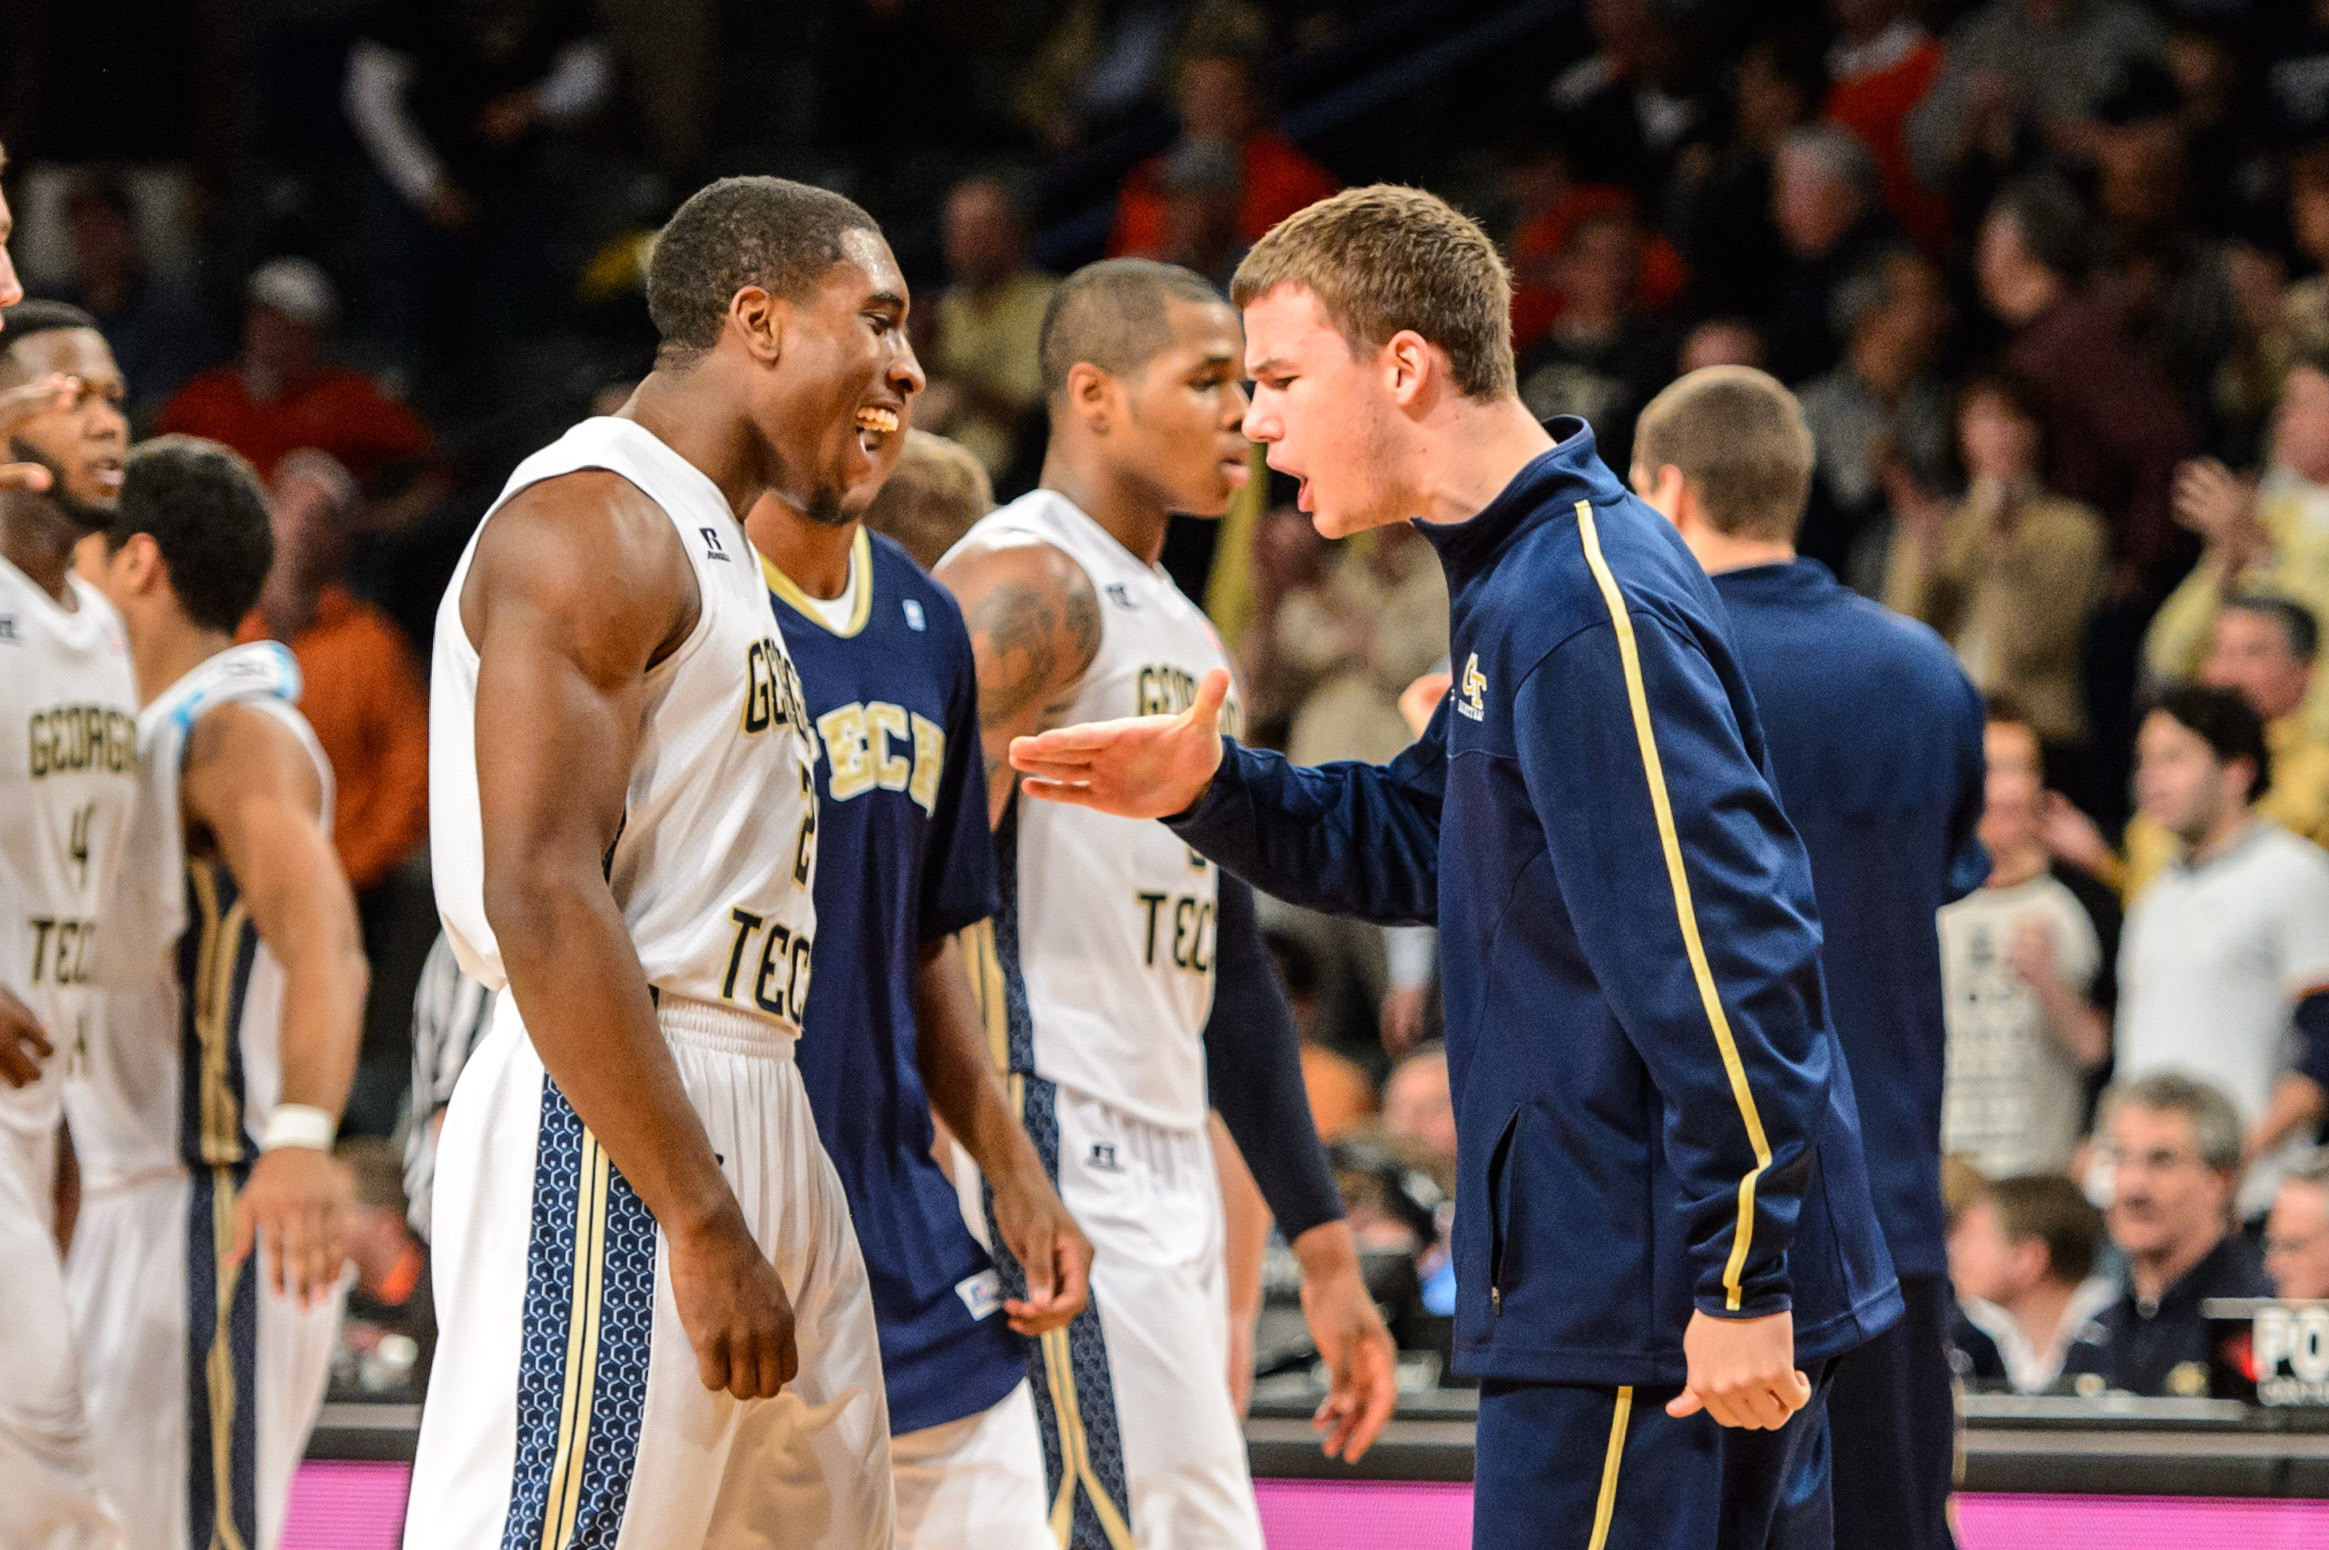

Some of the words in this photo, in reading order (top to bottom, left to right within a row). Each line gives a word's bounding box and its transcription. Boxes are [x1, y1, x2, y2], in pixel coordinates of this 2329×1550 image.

[808, 700, 946, 819] ECH
[29, 916, 98, 985] TEC
[720, 905, 811, 1028] TEC
[1133, 889, 1216, 974] TEC
